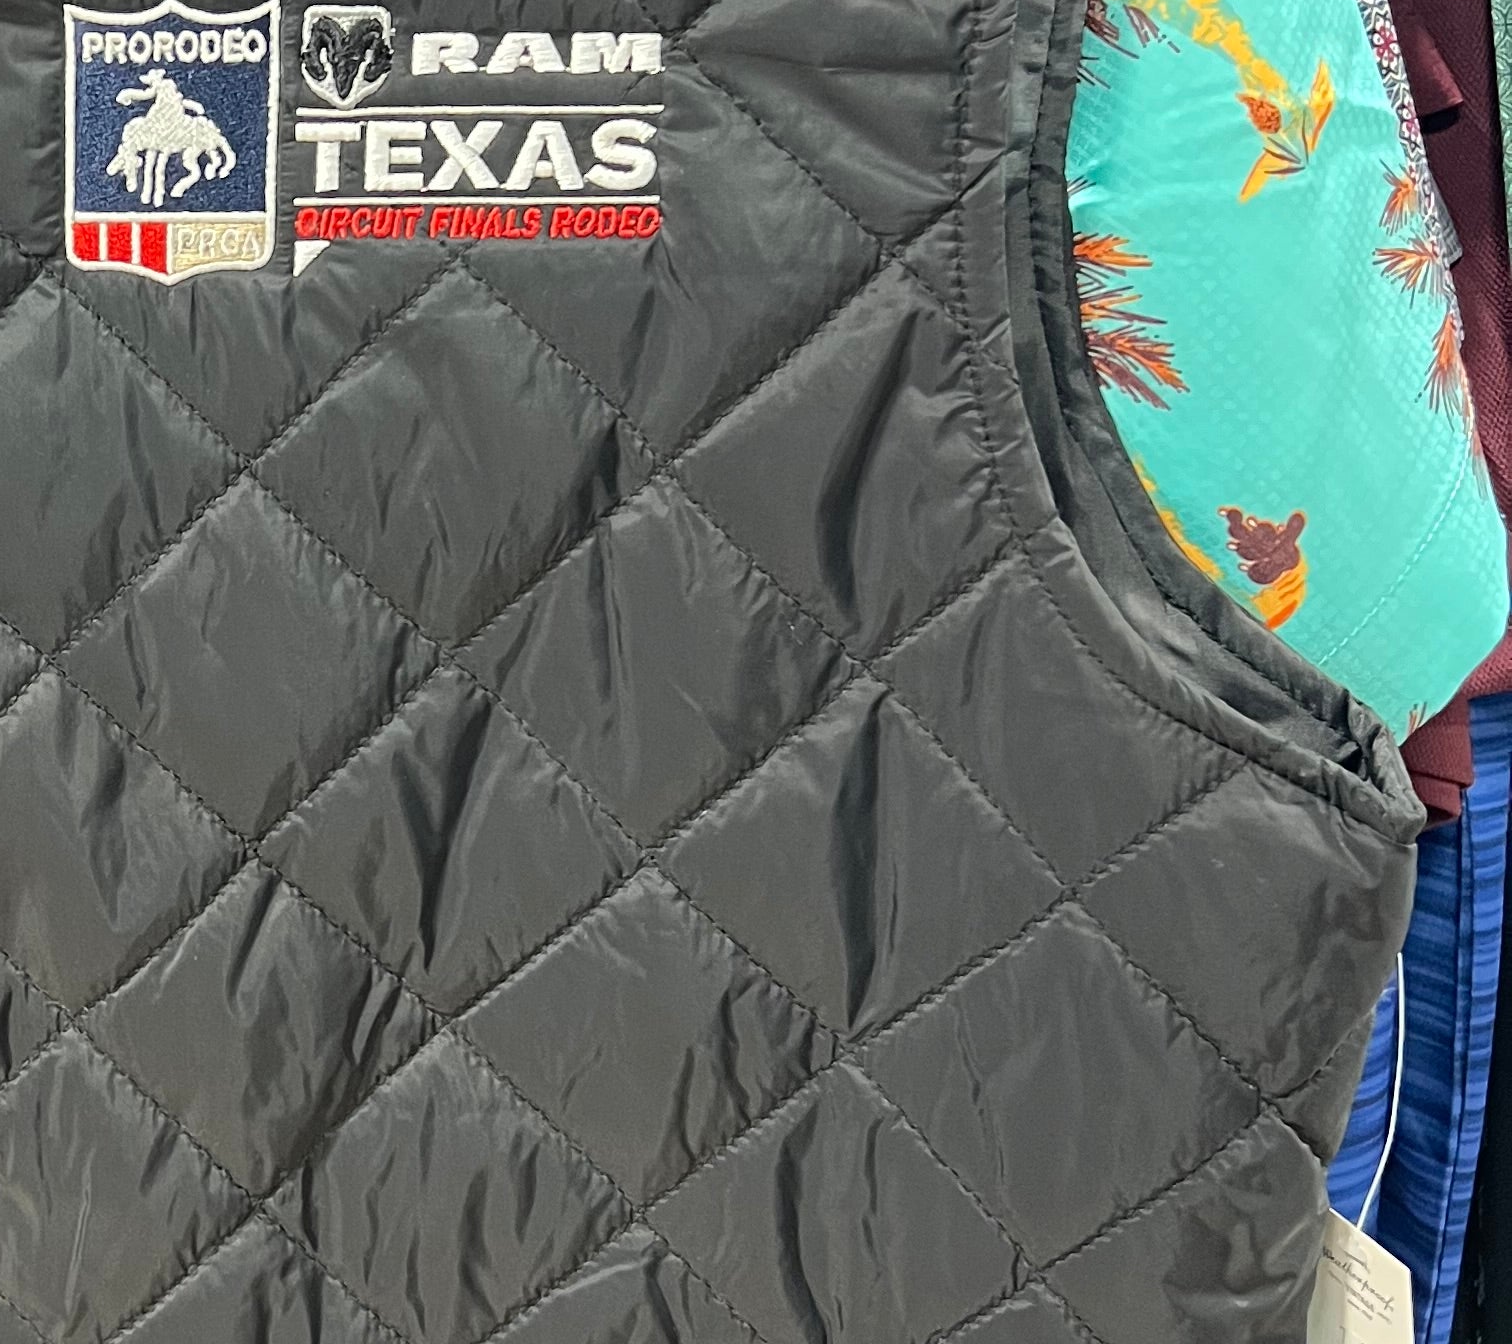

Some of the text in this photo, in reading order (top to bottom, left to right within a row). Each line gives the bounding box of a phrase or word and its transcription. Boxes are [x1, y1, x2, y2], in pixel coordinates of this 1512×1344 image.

[81, 27, 267, 65] PRORODEO
[411, 31, 665, 75] RAM
[294, 119, 659, 194] TEXAS
[294, 205, 662, 239] CIRCUIT FINALS RODEO
[176, 228, 261, 258] PRCA
